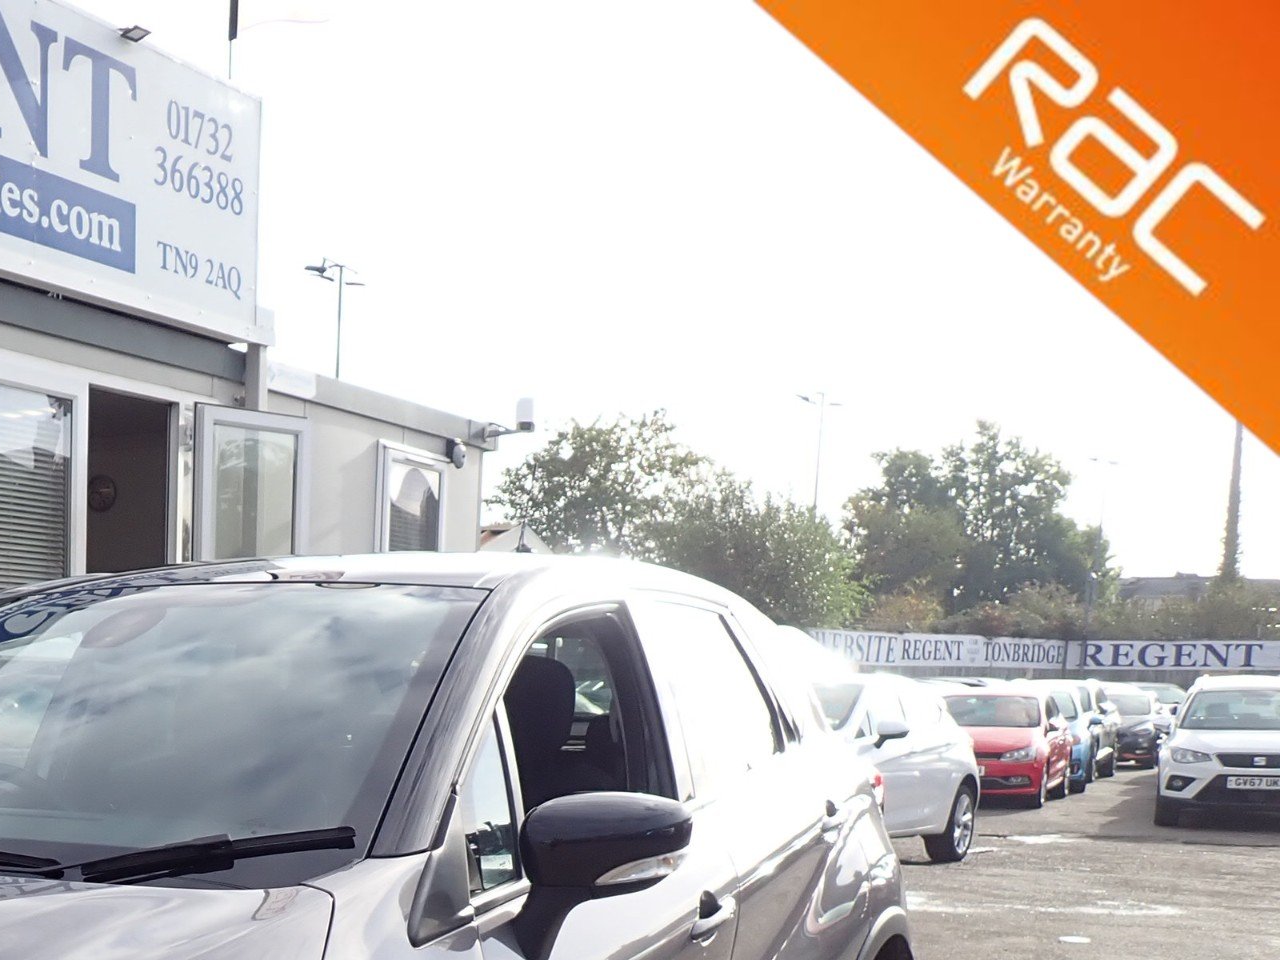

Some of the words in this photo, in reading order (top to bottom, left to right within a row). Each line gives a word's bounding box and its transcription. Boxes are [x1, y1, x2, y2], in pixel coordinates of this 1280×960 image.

[166, 99, 233, 163] 01732
[153, 146, 244, 216] 366388
[156, 240, 199, 279] TN9
[204, 258, 242, 300] 2AQ
[901, 638, 964, 662] REGENT
[983, 641, 1065, 664] TONBRIDGE
[1075, 643, 1264, 668] REGENT
